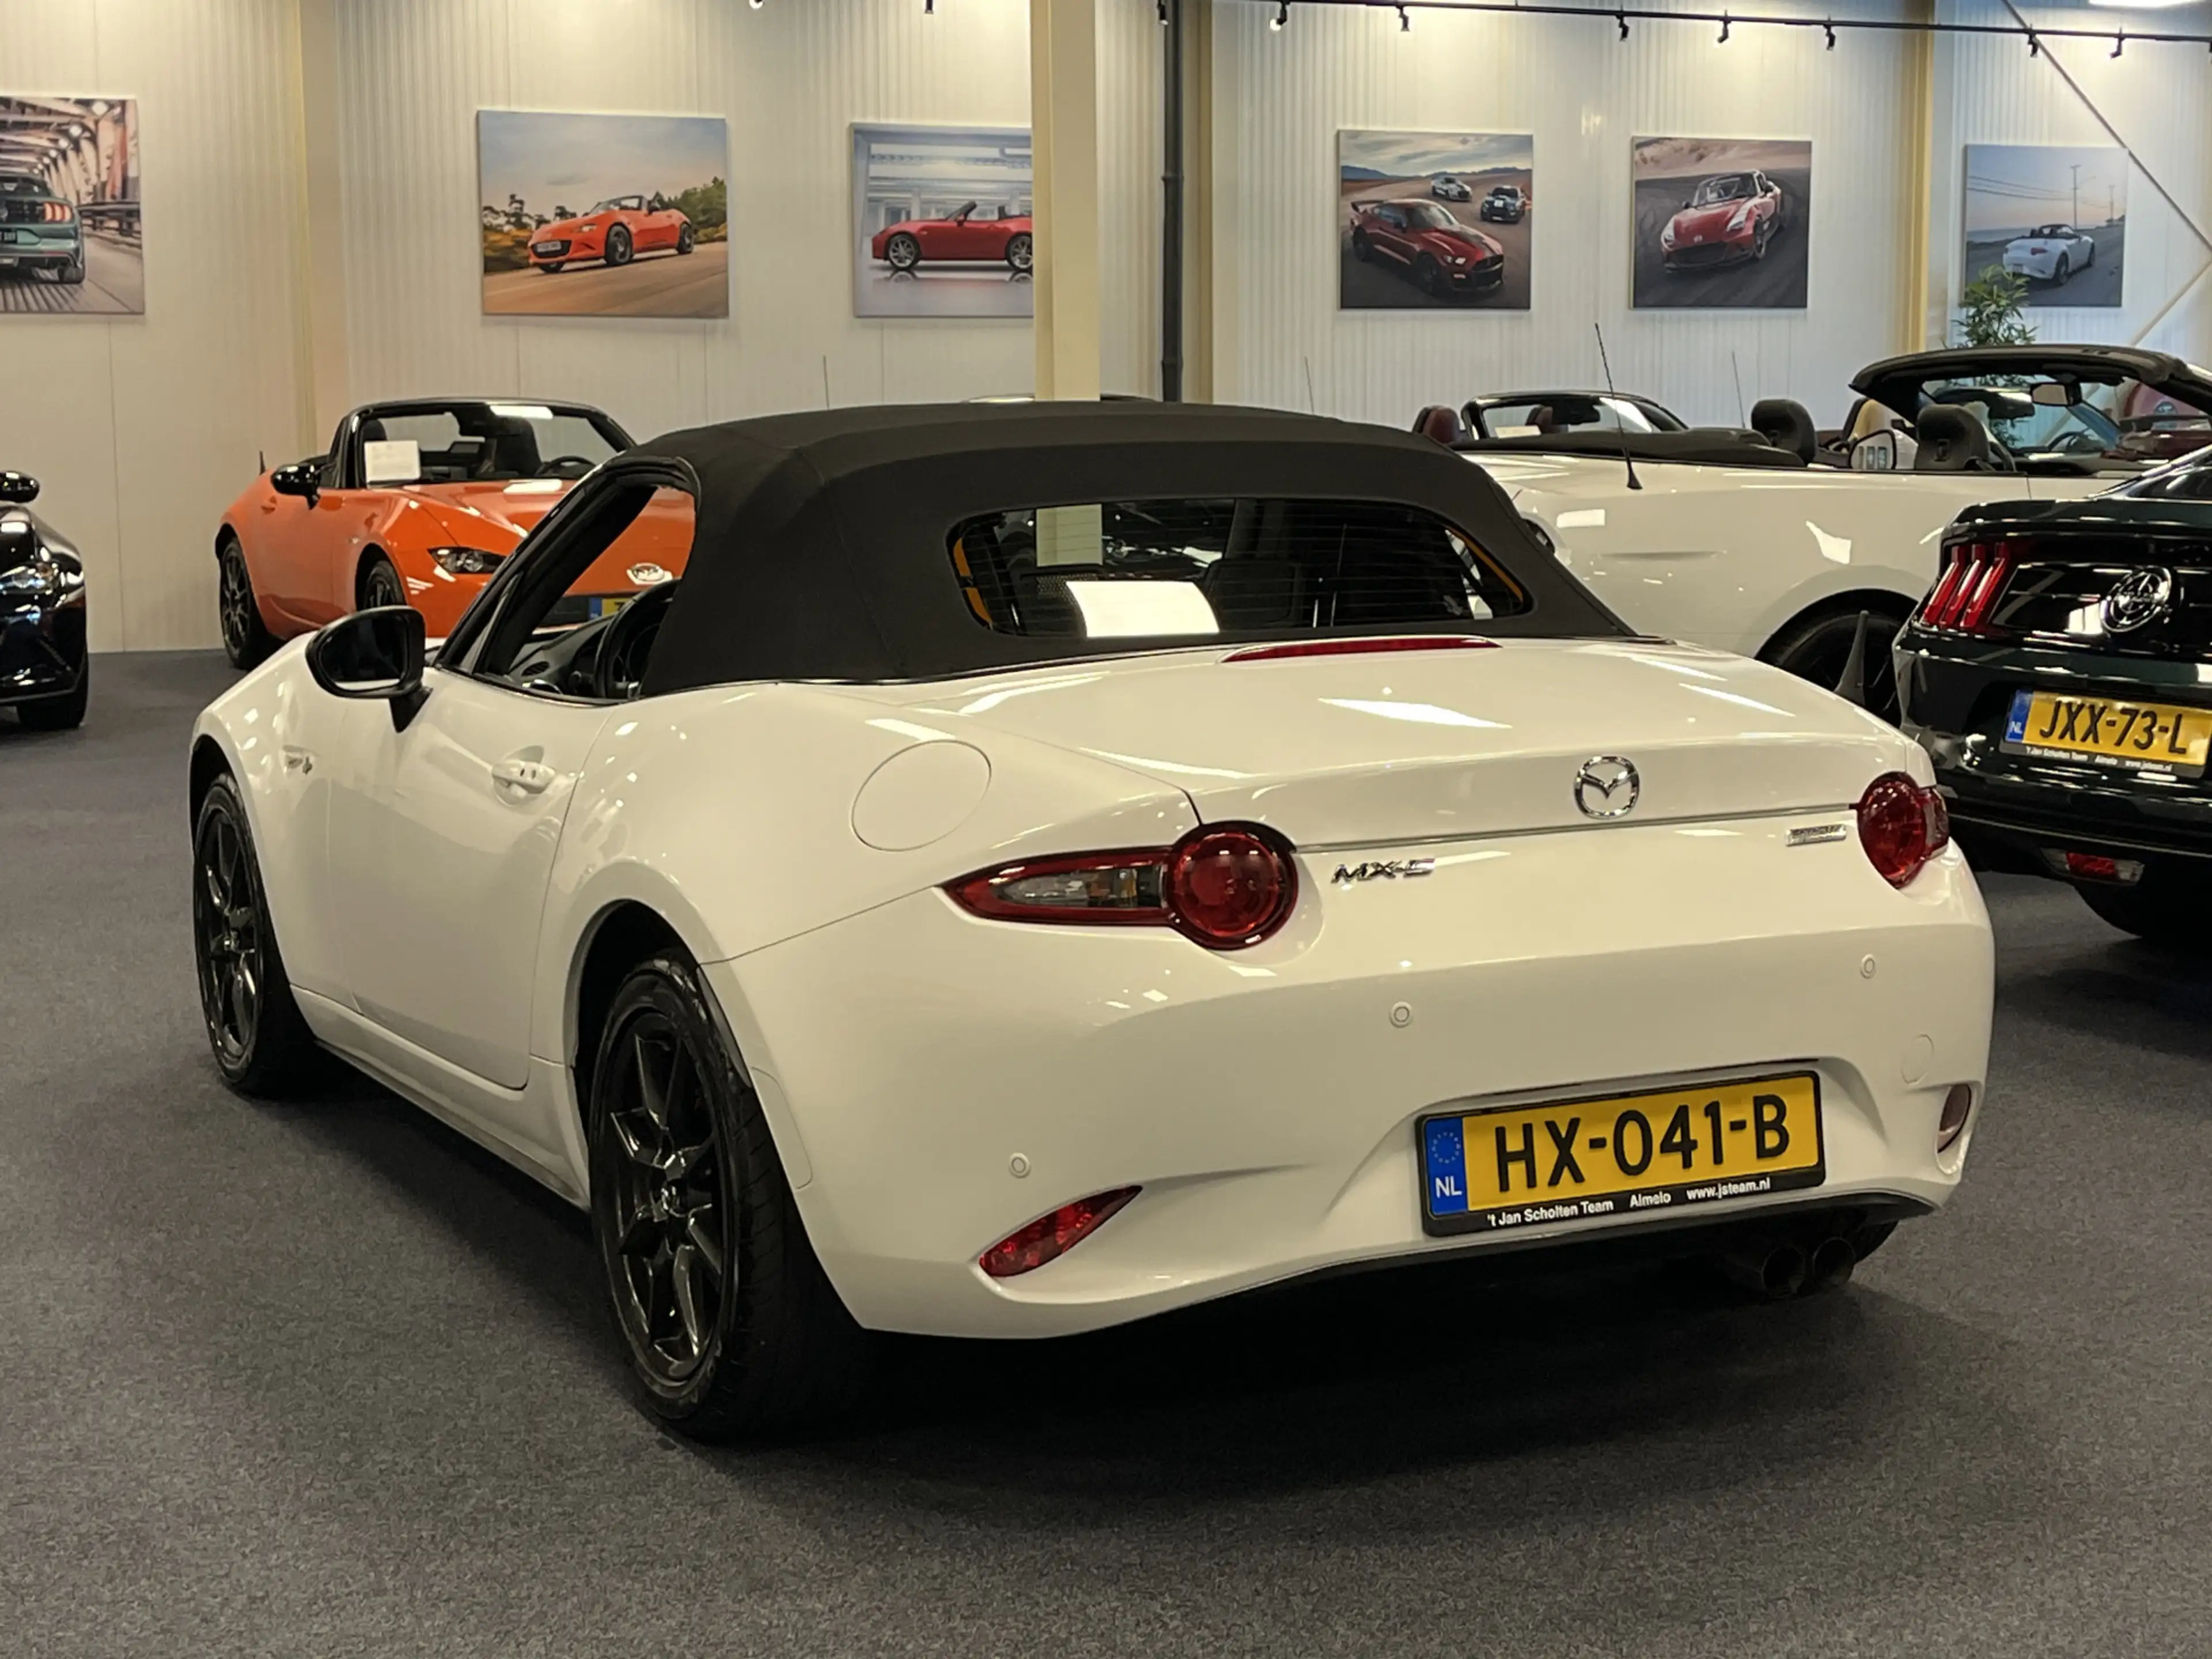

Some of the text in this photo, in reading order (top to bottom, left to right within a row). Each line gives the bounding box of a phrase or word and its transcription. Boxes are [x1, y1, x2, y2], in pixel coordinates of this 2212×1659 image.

[2039, 700, 2187, 755] JXX-73-L
[1495, 1094, 1790, 1192] HX-041-B
[1435, 1176, 1463, 1198] NL
[1498, 1211, 1521, 1225] Jan
[1524, 1205, 1578, 1222] Scholten
[1580, 1199, 1614, 1214] Team
[1629, 1191, 1672, 1208] Almelo
[1686, 1177, 1771, 1200] www.jsteam.nl
